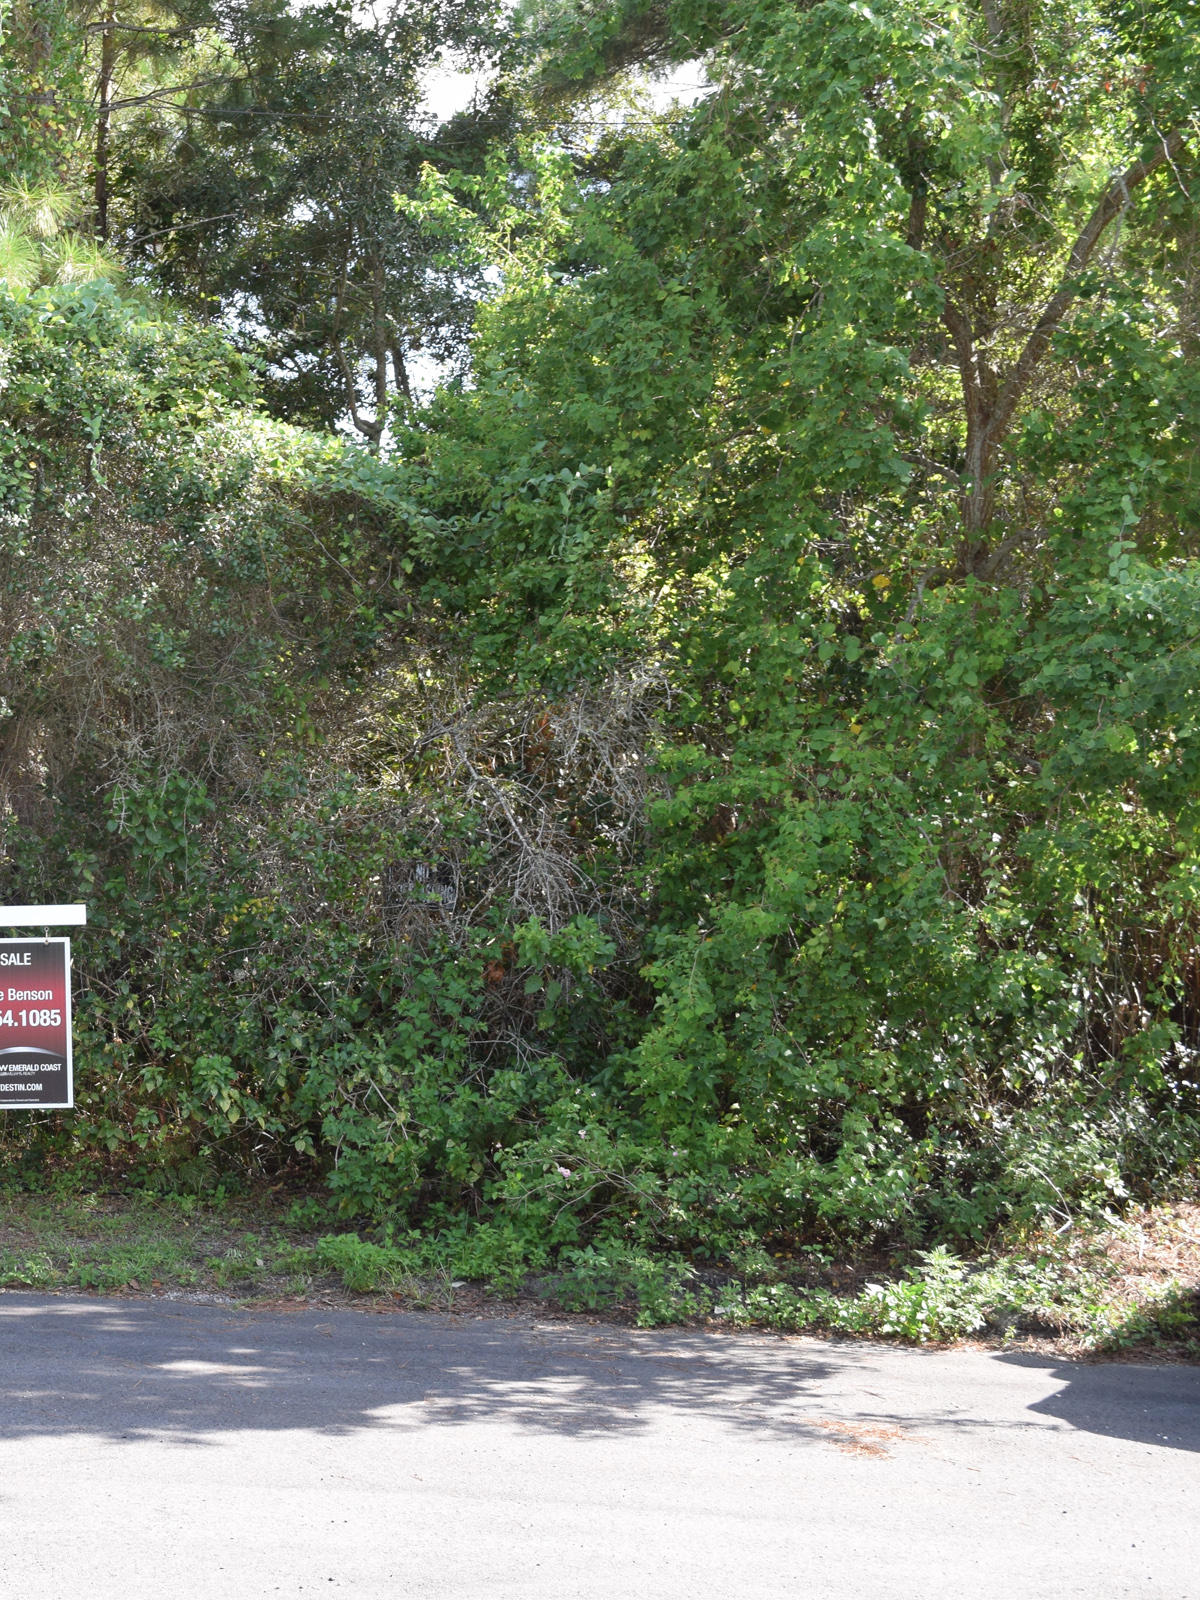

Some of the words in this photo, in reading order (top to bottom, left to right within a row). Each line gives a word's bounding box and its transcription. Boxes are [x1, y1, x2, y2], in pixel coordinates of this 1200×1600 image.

[0, 953, 31, 966] SALE
[8, 988, 52, 1001] Benson
[8, 1064, 39, 1072] EMERALD
[40, 1063, 61, 1071] COAST
